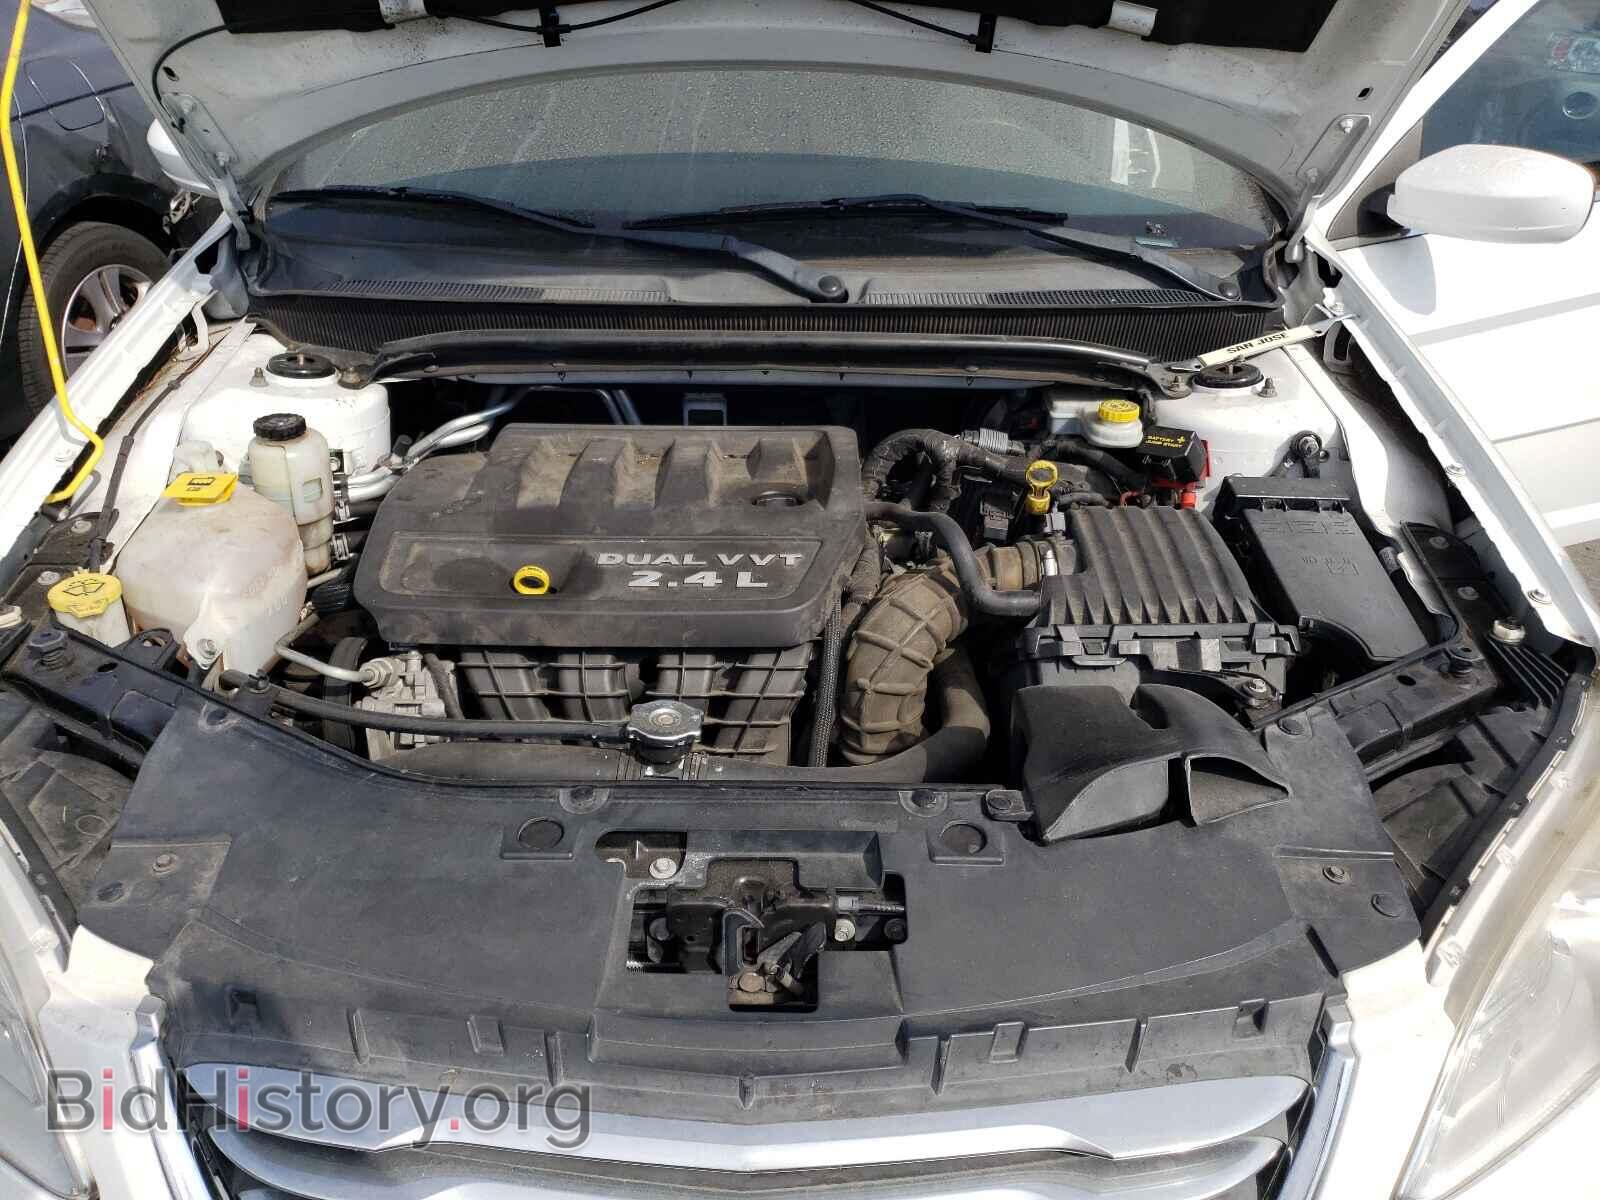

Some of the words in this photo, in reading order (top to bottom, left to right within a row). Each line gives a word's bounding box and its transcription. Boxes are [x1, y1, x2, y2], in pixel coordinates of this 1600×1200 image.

[1227, 342, 1255, 354] SAN
[1258, 332, 1290, 346] JOSE
[597, 552, 708, 566] DUAL
[716, 552, 804, 567] VVT
